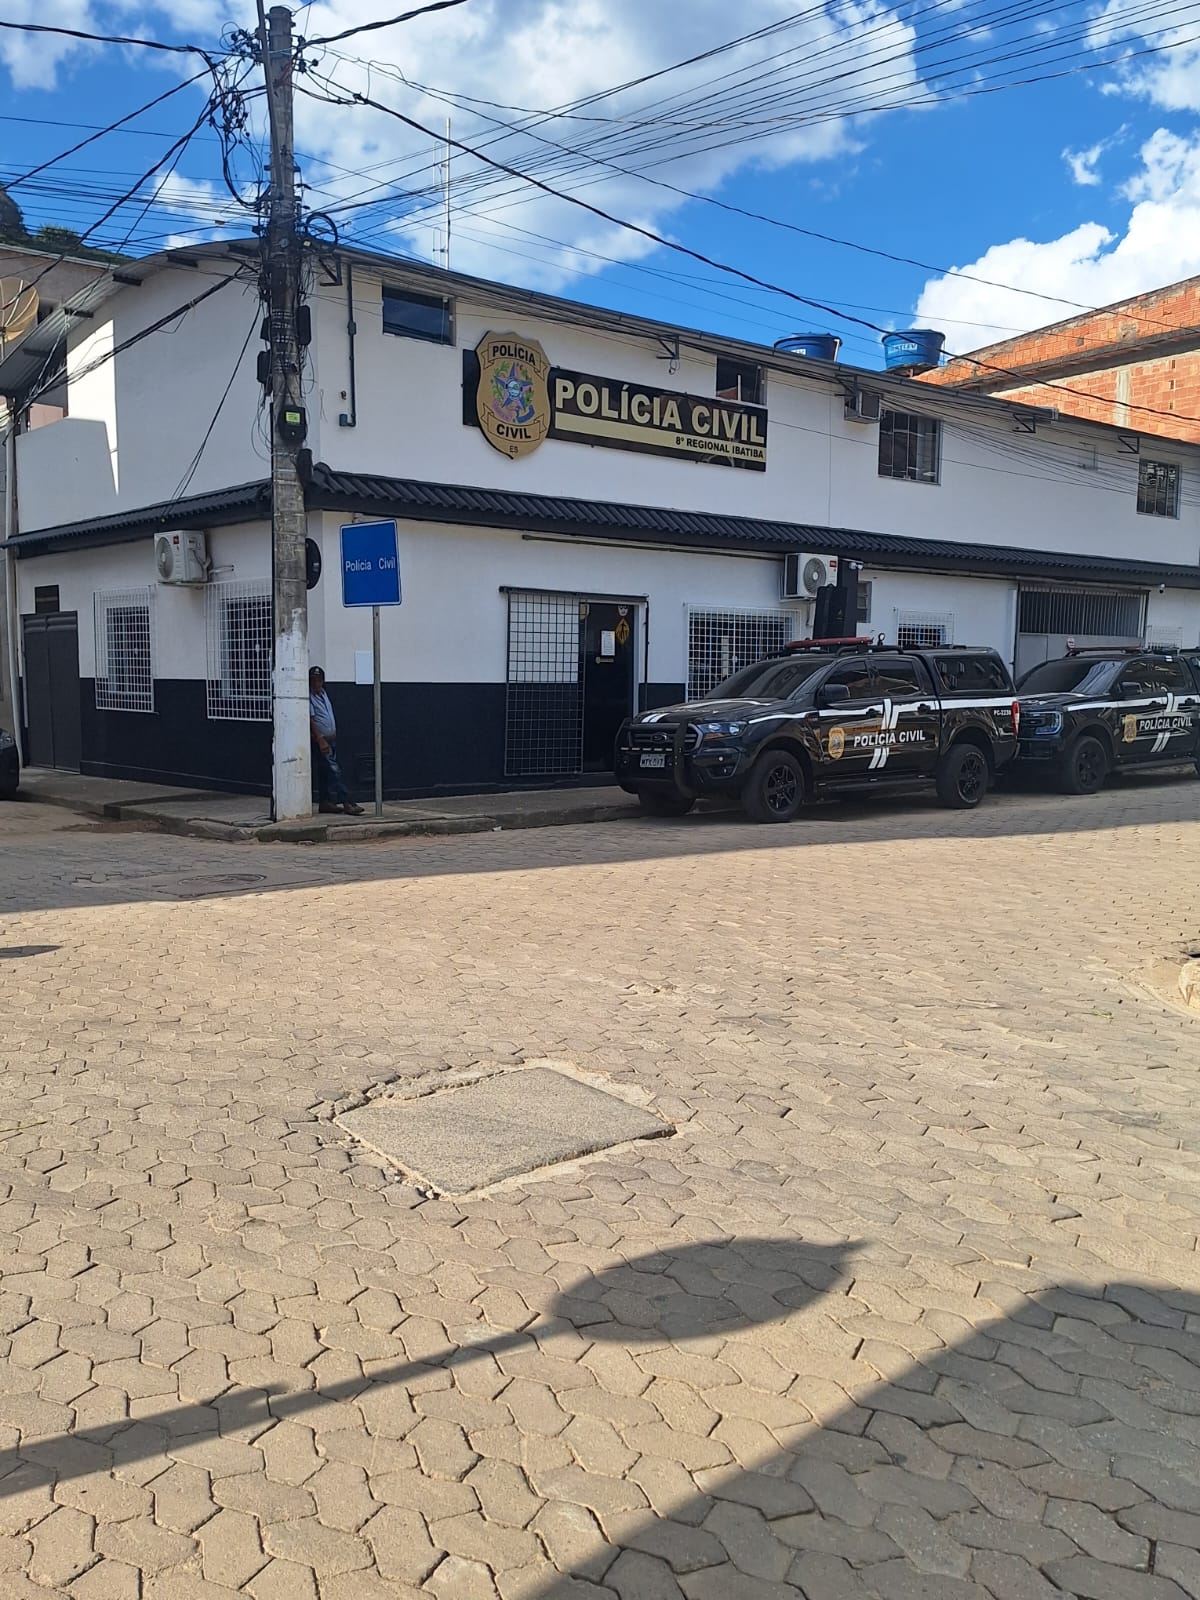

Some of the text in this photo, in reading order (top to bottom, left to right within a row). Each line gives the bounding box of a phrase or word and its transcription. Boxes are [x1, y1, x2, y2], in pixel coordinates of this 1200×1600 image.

[492, 343, 536, 366] POLÍCIA
[555, 378, 765, 443] POLÍCIA CIVIL
[496, 423, 531, 440] CIVIL
[509, 445, 519, 453] ES
[686, 438, 730, 453] REGIONAL
[732, 445, 764, 459] IBATIBA
[378, 556, 396, 570] Civil
[1172, 716, 1193, 728] CIVIL
[899, 729, 926, 743] CIVIL
